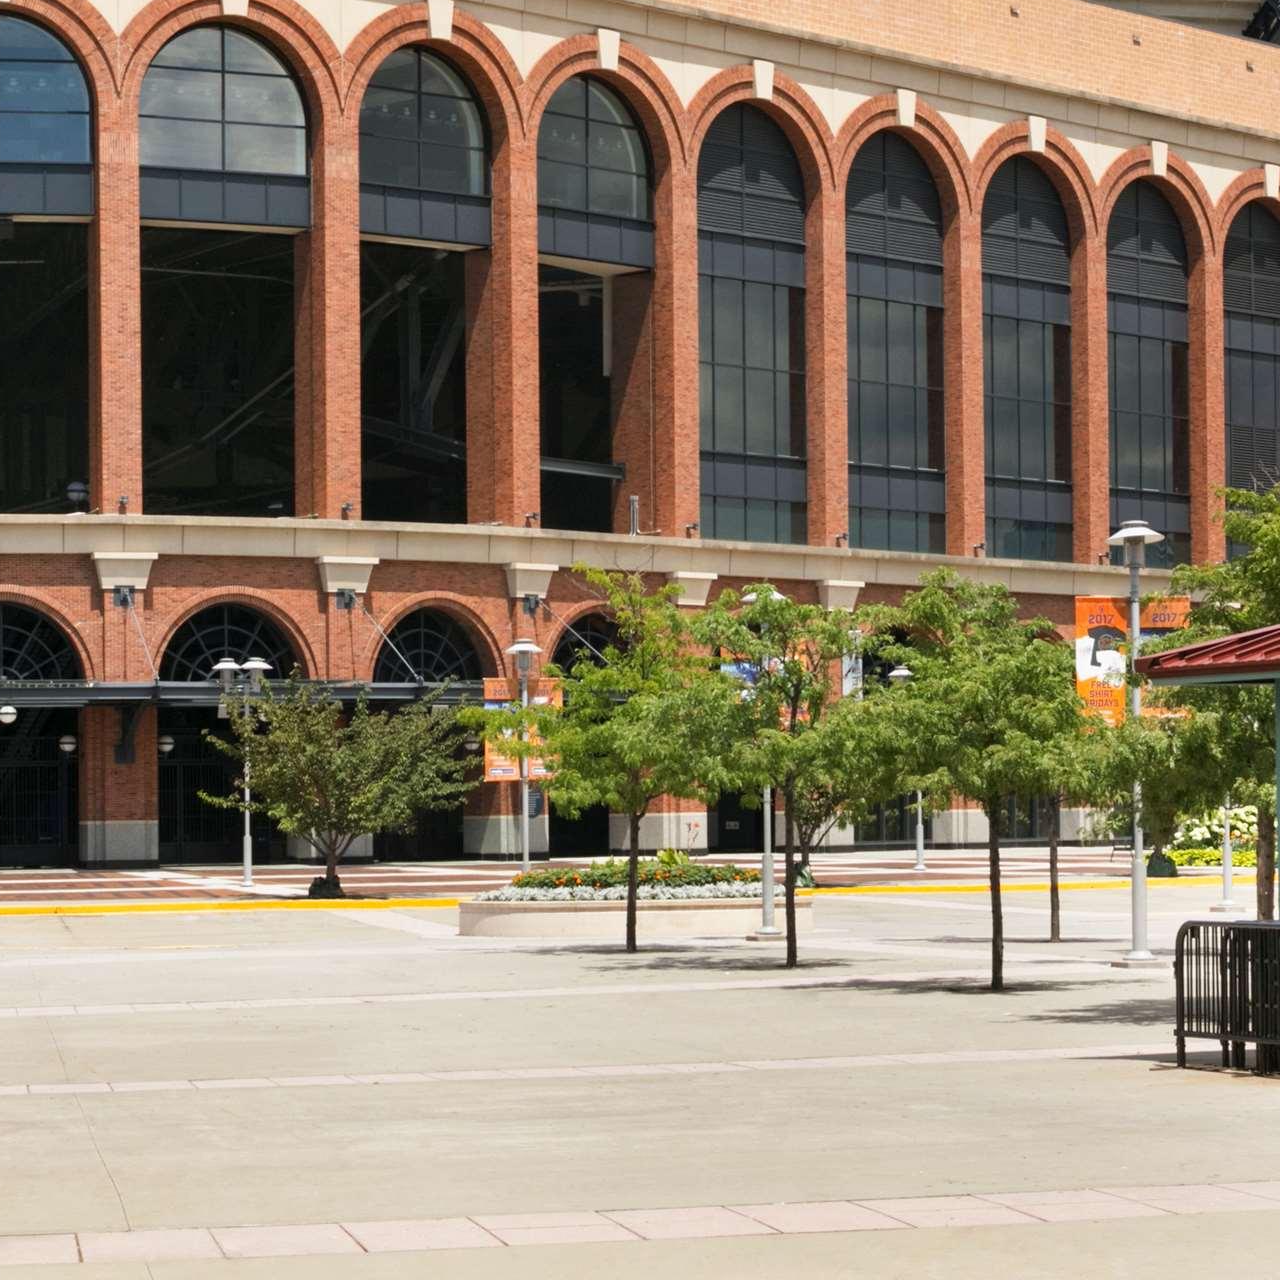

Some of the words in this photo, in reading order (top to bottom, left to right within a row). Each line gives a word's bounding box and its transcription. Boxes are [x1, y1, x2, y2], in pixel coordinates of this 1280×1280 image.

[1087, 613, 1114, 625] 2017
[1151, 612, 1176, 623] 2017
[1086, 698, 1119, 708] RIDAYS
